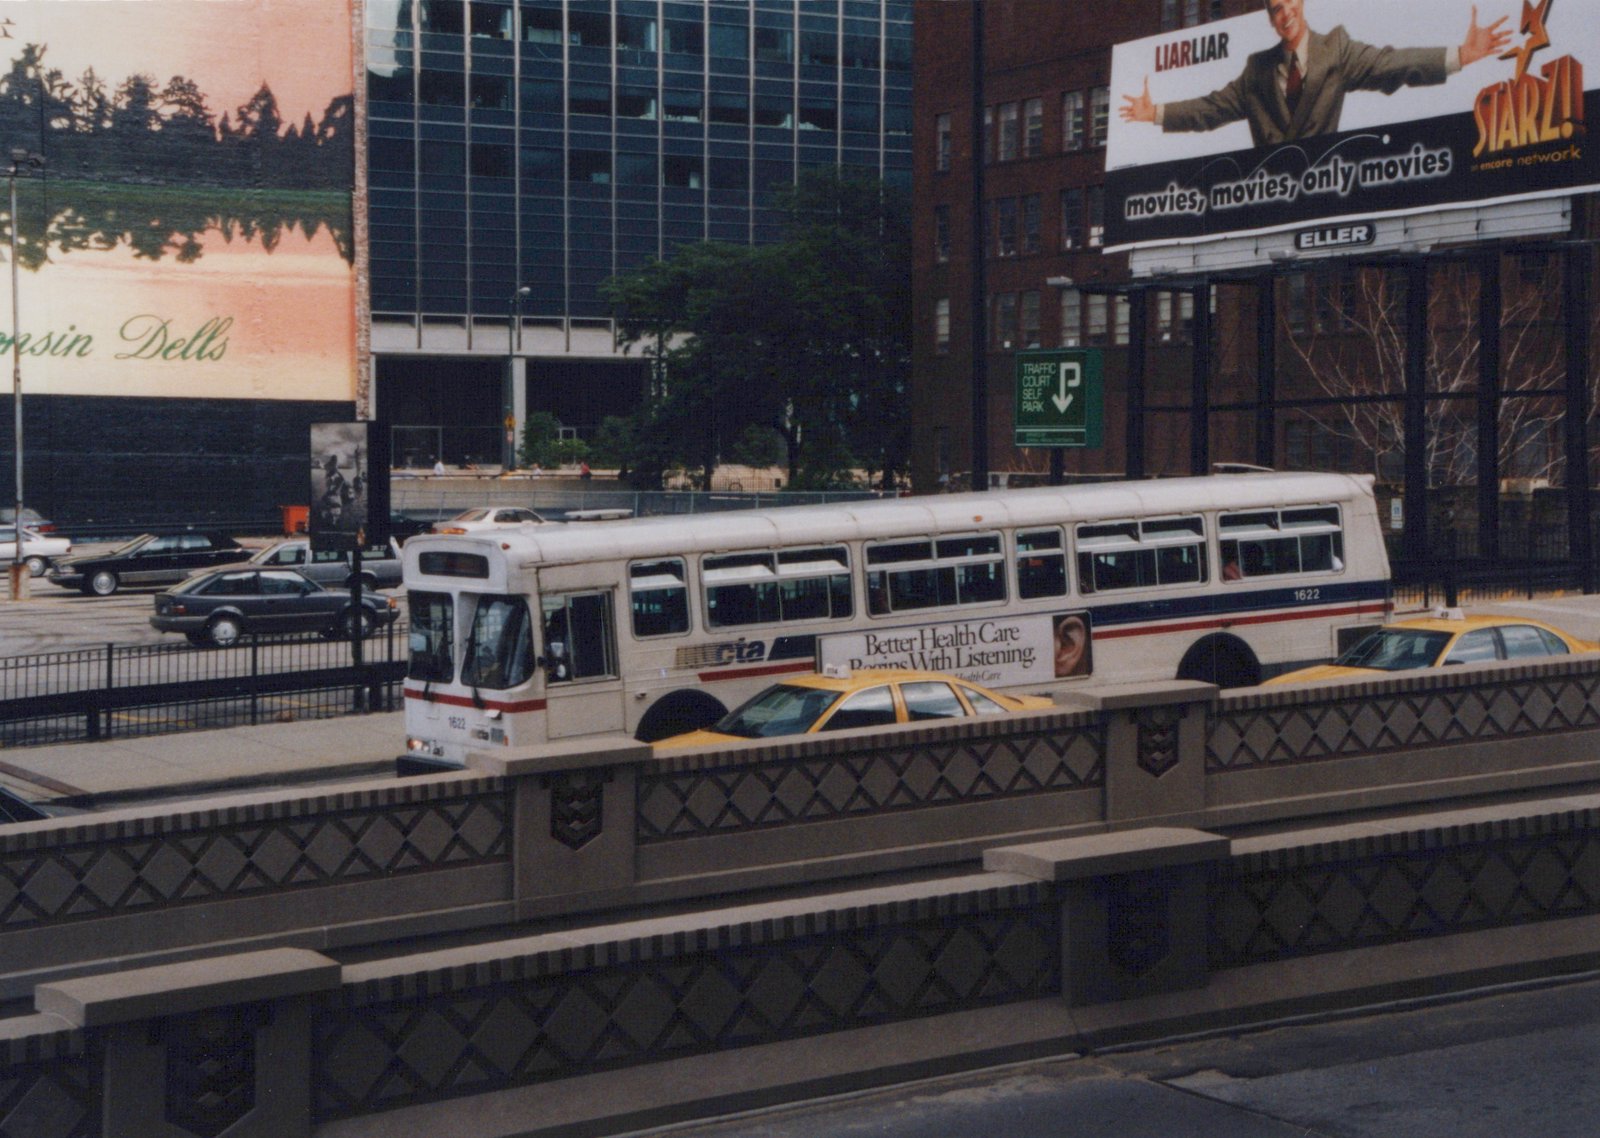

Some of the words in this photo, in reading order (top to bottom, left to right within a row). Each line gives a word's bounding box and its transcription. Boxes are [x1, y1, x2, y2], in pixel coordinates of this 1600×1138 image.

[1472, 54, 1583, 158] STARZ!
[1517, 143, 1581, 166] network
[1126, 183, 1206, 218] movies,
[1212, 171, 1297, 208] movies,
[1302, 157, 1354, 194] only
[1360, 145, 1451, 184] movies
[1300, 226, 1368, 248] ELLER
[114, 314, 234, 361] Dells
[1022, 362, 1056, 375] TRAFFIC
[1022, 375, 1051, 388] COURT
[1022, 388, 1042, 400] SELF
[1022, 401, 1045, 412] PARK
[1294, 588, 1320, 601] 1622
[864, 634, 917, 656] Better
[919, 624, 977, 650] Health
[979, 621, 1020, 643] Care
[715, 637, 765, 666] cta
[908, 648, 952, 671] With
[954, 643, 1036, 669] Listening.
[448, 715, 466, 730] 1622
